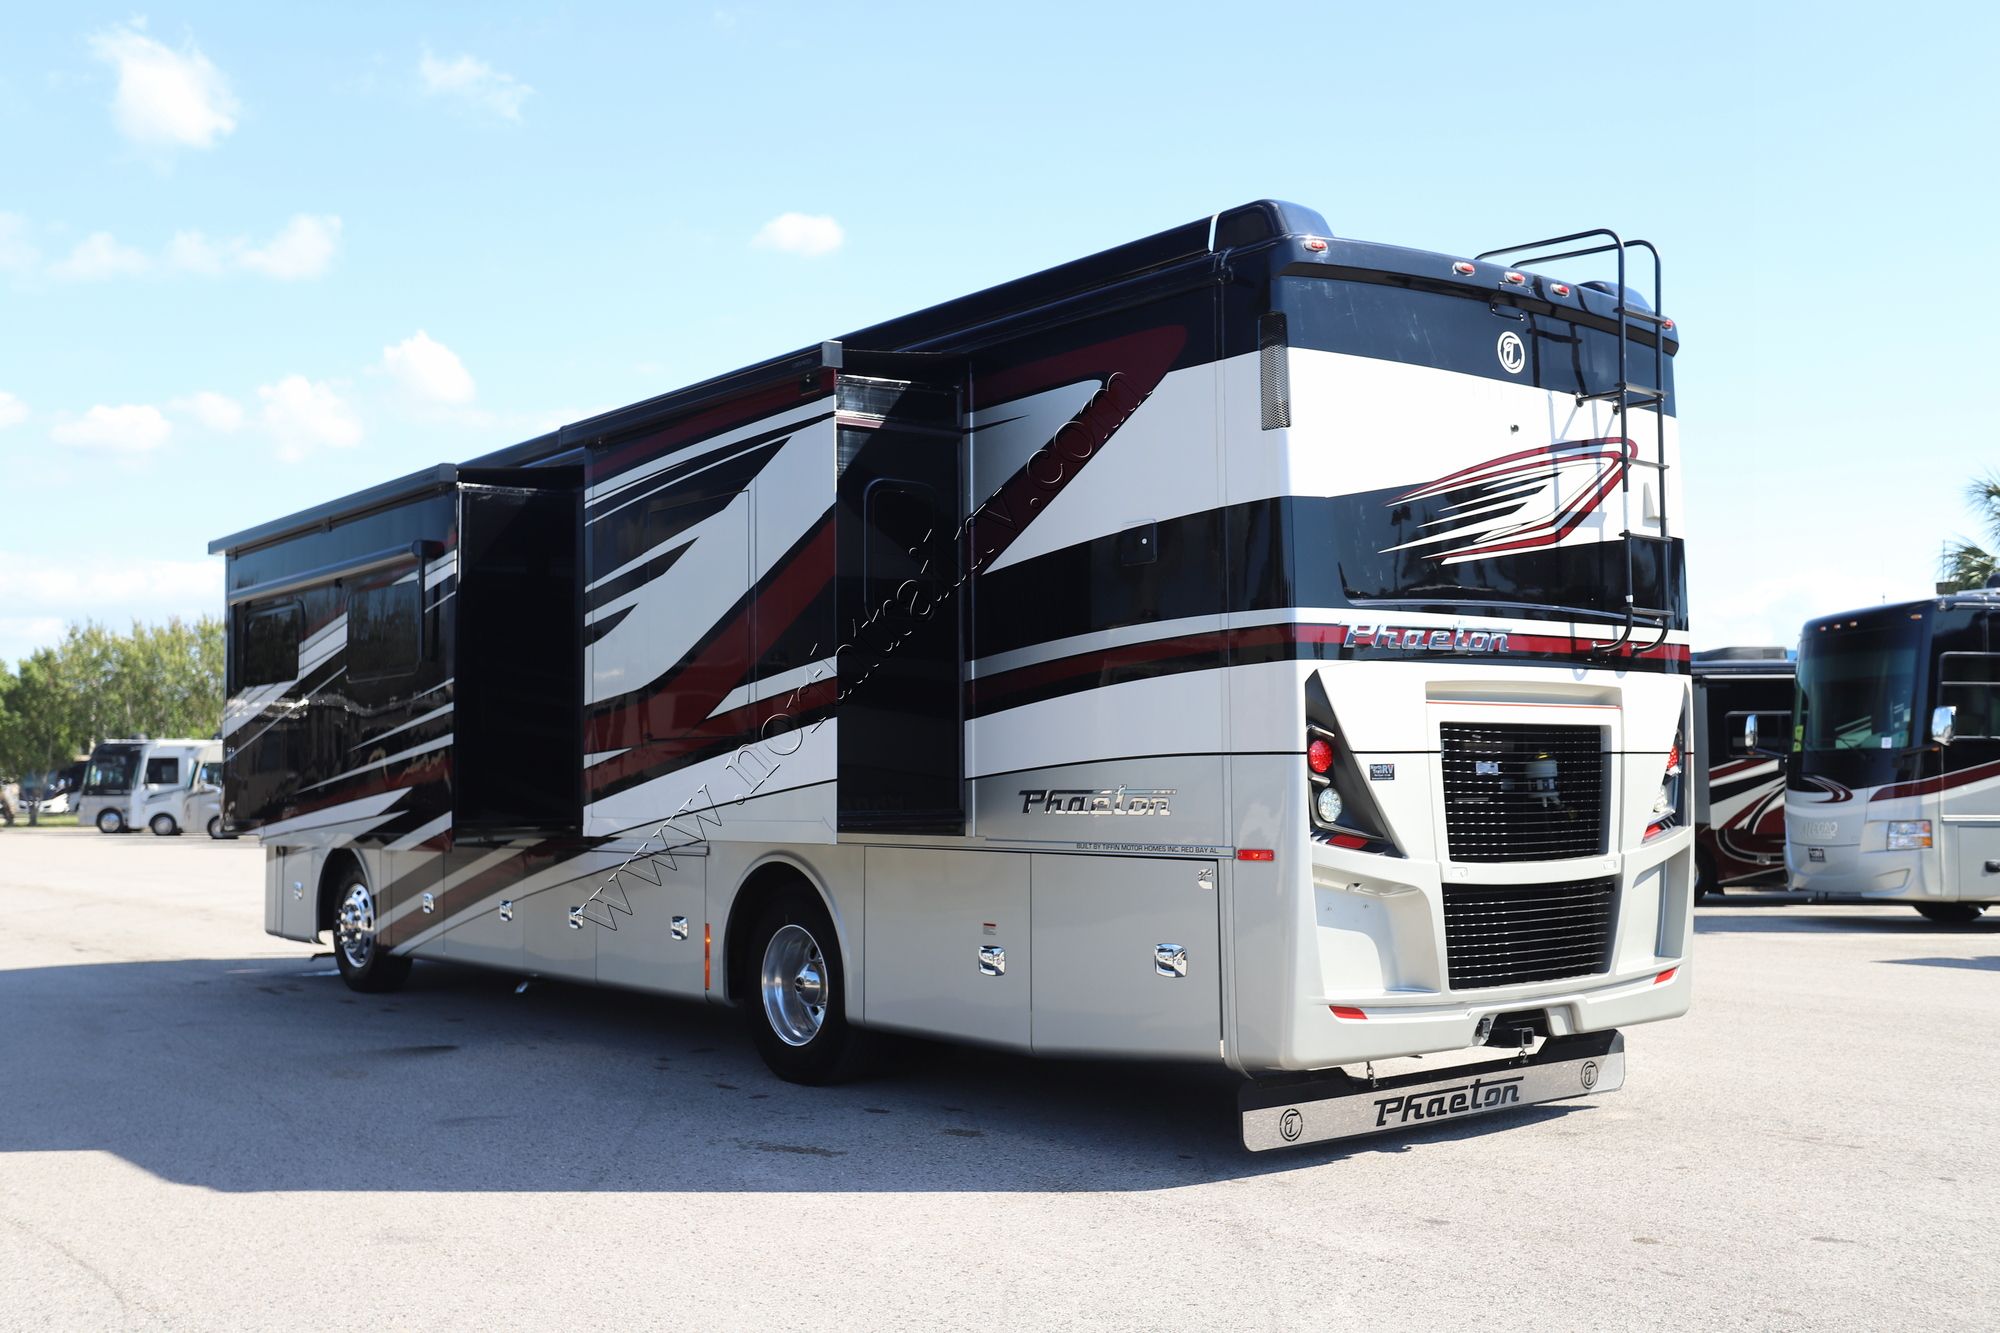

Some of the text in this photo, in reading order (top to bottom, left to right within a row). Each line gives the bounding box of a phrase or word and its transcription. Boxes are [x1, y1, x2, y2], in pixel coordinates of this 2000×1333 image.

[1338, 619, 1512, 652] Phaeton
[1018, 784, 1177, 816] Phaeton
[1076, 842, 1092, 850] BUILT
[1093, 842, 1102, 850] BY
[1102, 843, 1120, 851] TIFFIN
[1121, 844, 1142, 852] MOTOR
[1144, 845, 1166, 853] HOMES
[1180, 846, 1194, 854] RED
[1374, 1076, 1524, 1127] Phaeton
